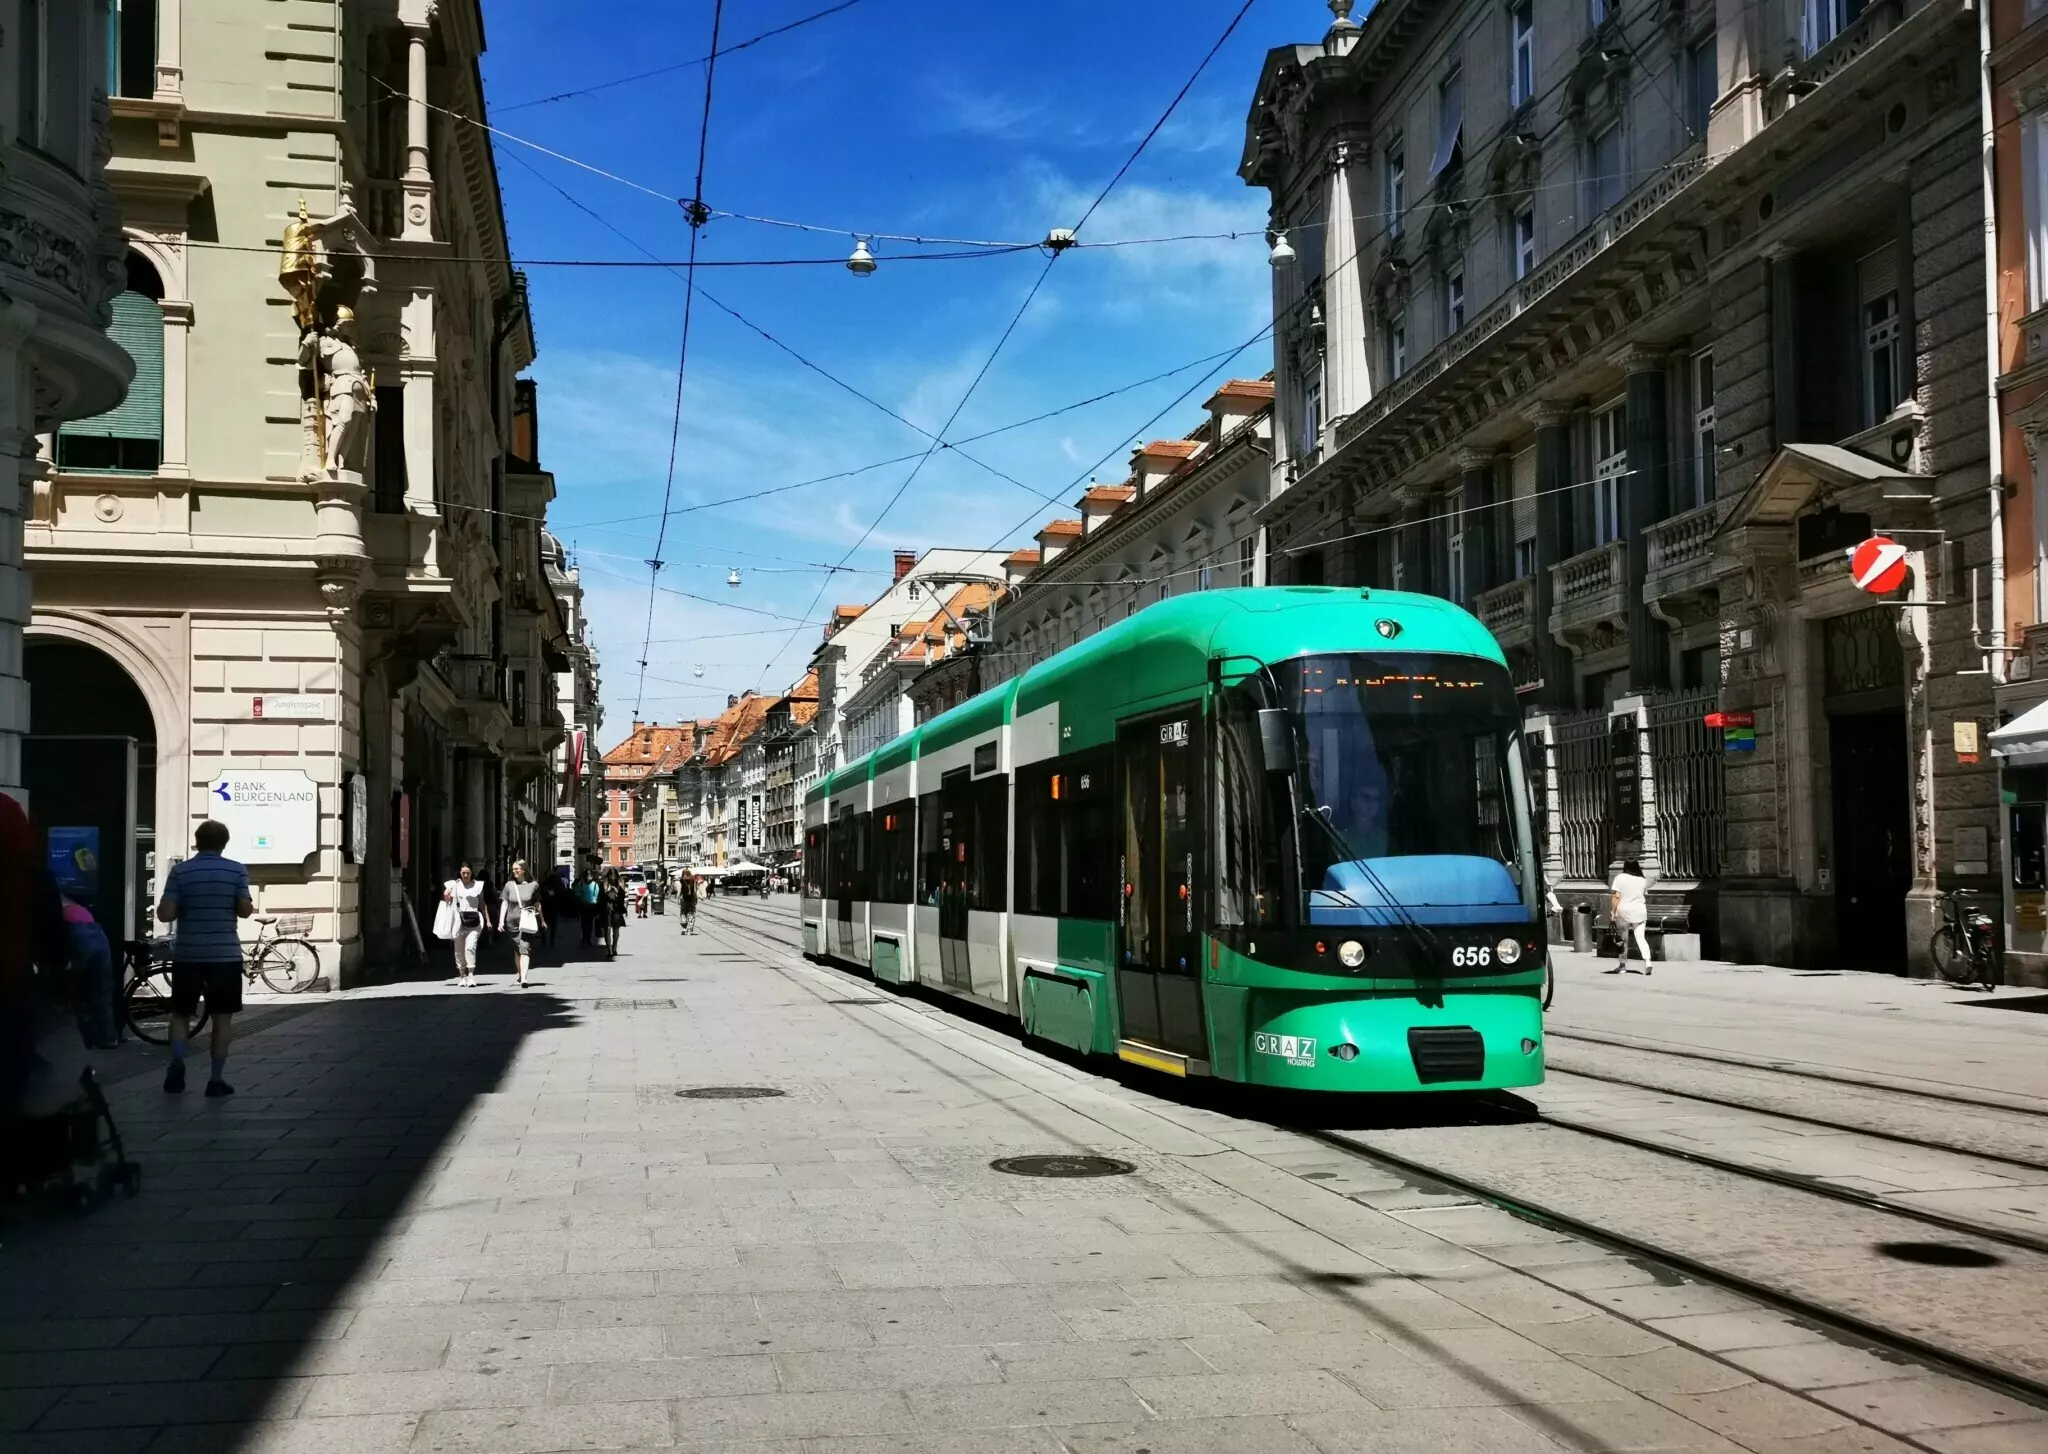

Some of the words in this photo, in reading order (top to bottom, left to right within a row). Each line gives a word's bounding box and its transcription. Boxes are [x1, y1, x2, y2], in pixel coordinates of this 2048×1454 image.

[1160, 721, 1188, 742] GRAZ
[234, 782, 266, 791] BANK
[234, 791, 314, 802] BURGENLAND
[752, 801, 760, 840] HUMANIC
[1452, 946, 1491, 967] 656
[1255, 1033, 1315, 1058] GRAZ
[1287, 1058, 1315, 1068] HOLDING
